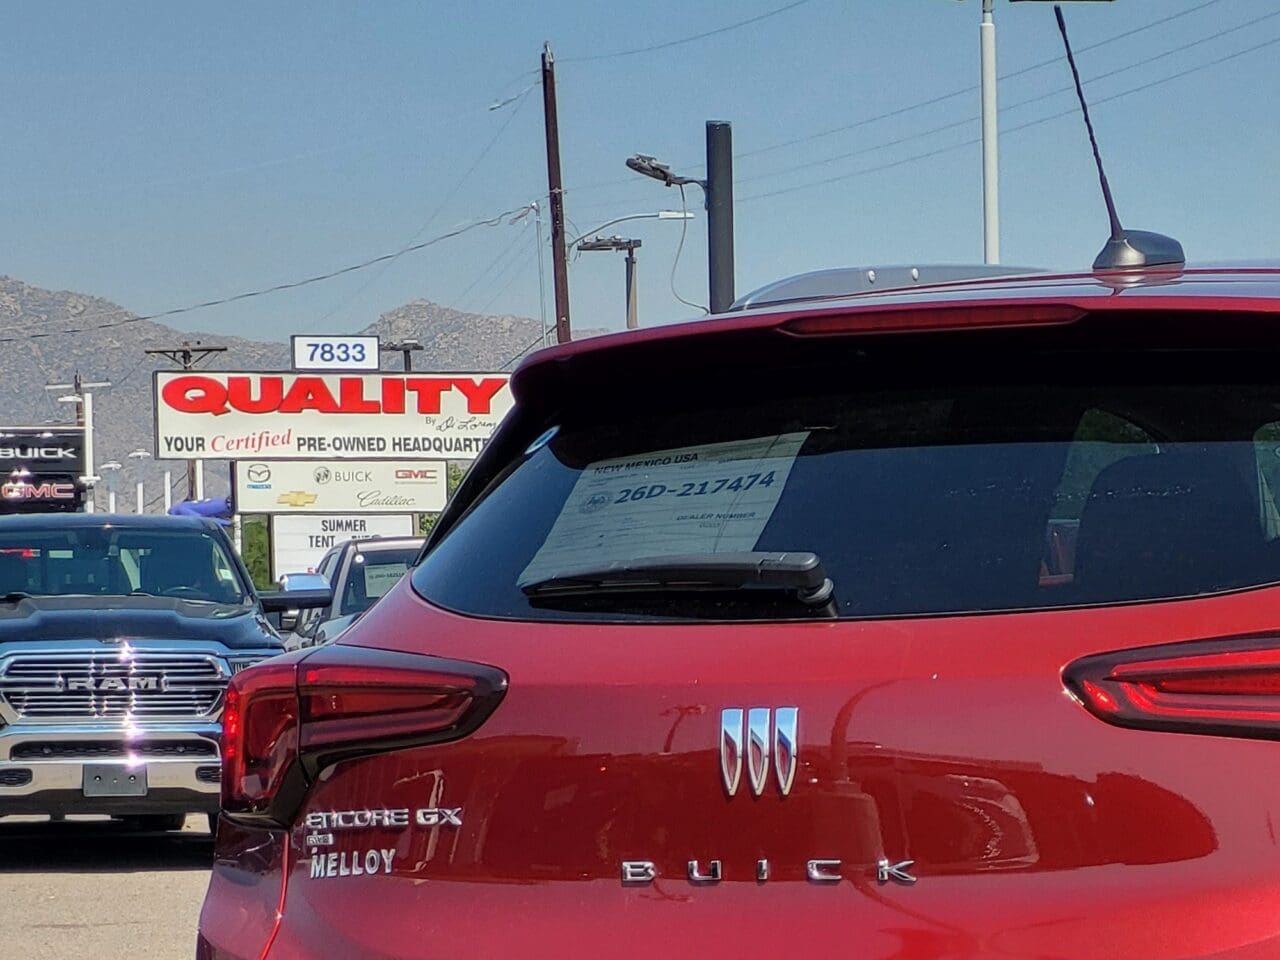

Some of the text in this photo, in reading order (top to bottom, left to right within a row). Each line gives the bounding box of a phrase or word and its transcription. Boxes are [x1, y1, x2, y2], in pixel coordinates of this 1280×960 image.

[307, 343, 366, 362] 7833
[162, 376, 507, 415] QUALITY
[425, 416, 436, 426] By
[164, 436, 206, 452] YOUR
[211, 428, 292, 453] Certified
[297, 437, 386, 452] PRE-OWNED
[0, 447, 77, 459] BUICK
[594, 465, 624, 475] NEW
[625, 457, 671, 471] MEXICO
[675, 453, 698, 463] USA
[334, 469, 438, 482] BUICK GMC
[2, 483, 75, 498] GMC
[614, 470, 776, 504] 26D-217474
[716, 511, 756, 519] NUMBER
[321, 519, 367, 533] SUMMER
[308, 535, 336, 549] TENT
[68, 677, 158, 691] RAM
[305, 807, 463, 829] ENCORE GX
[310, 848, 396, 880] MELLOY
[621, 858, 918, 883] BUICK
